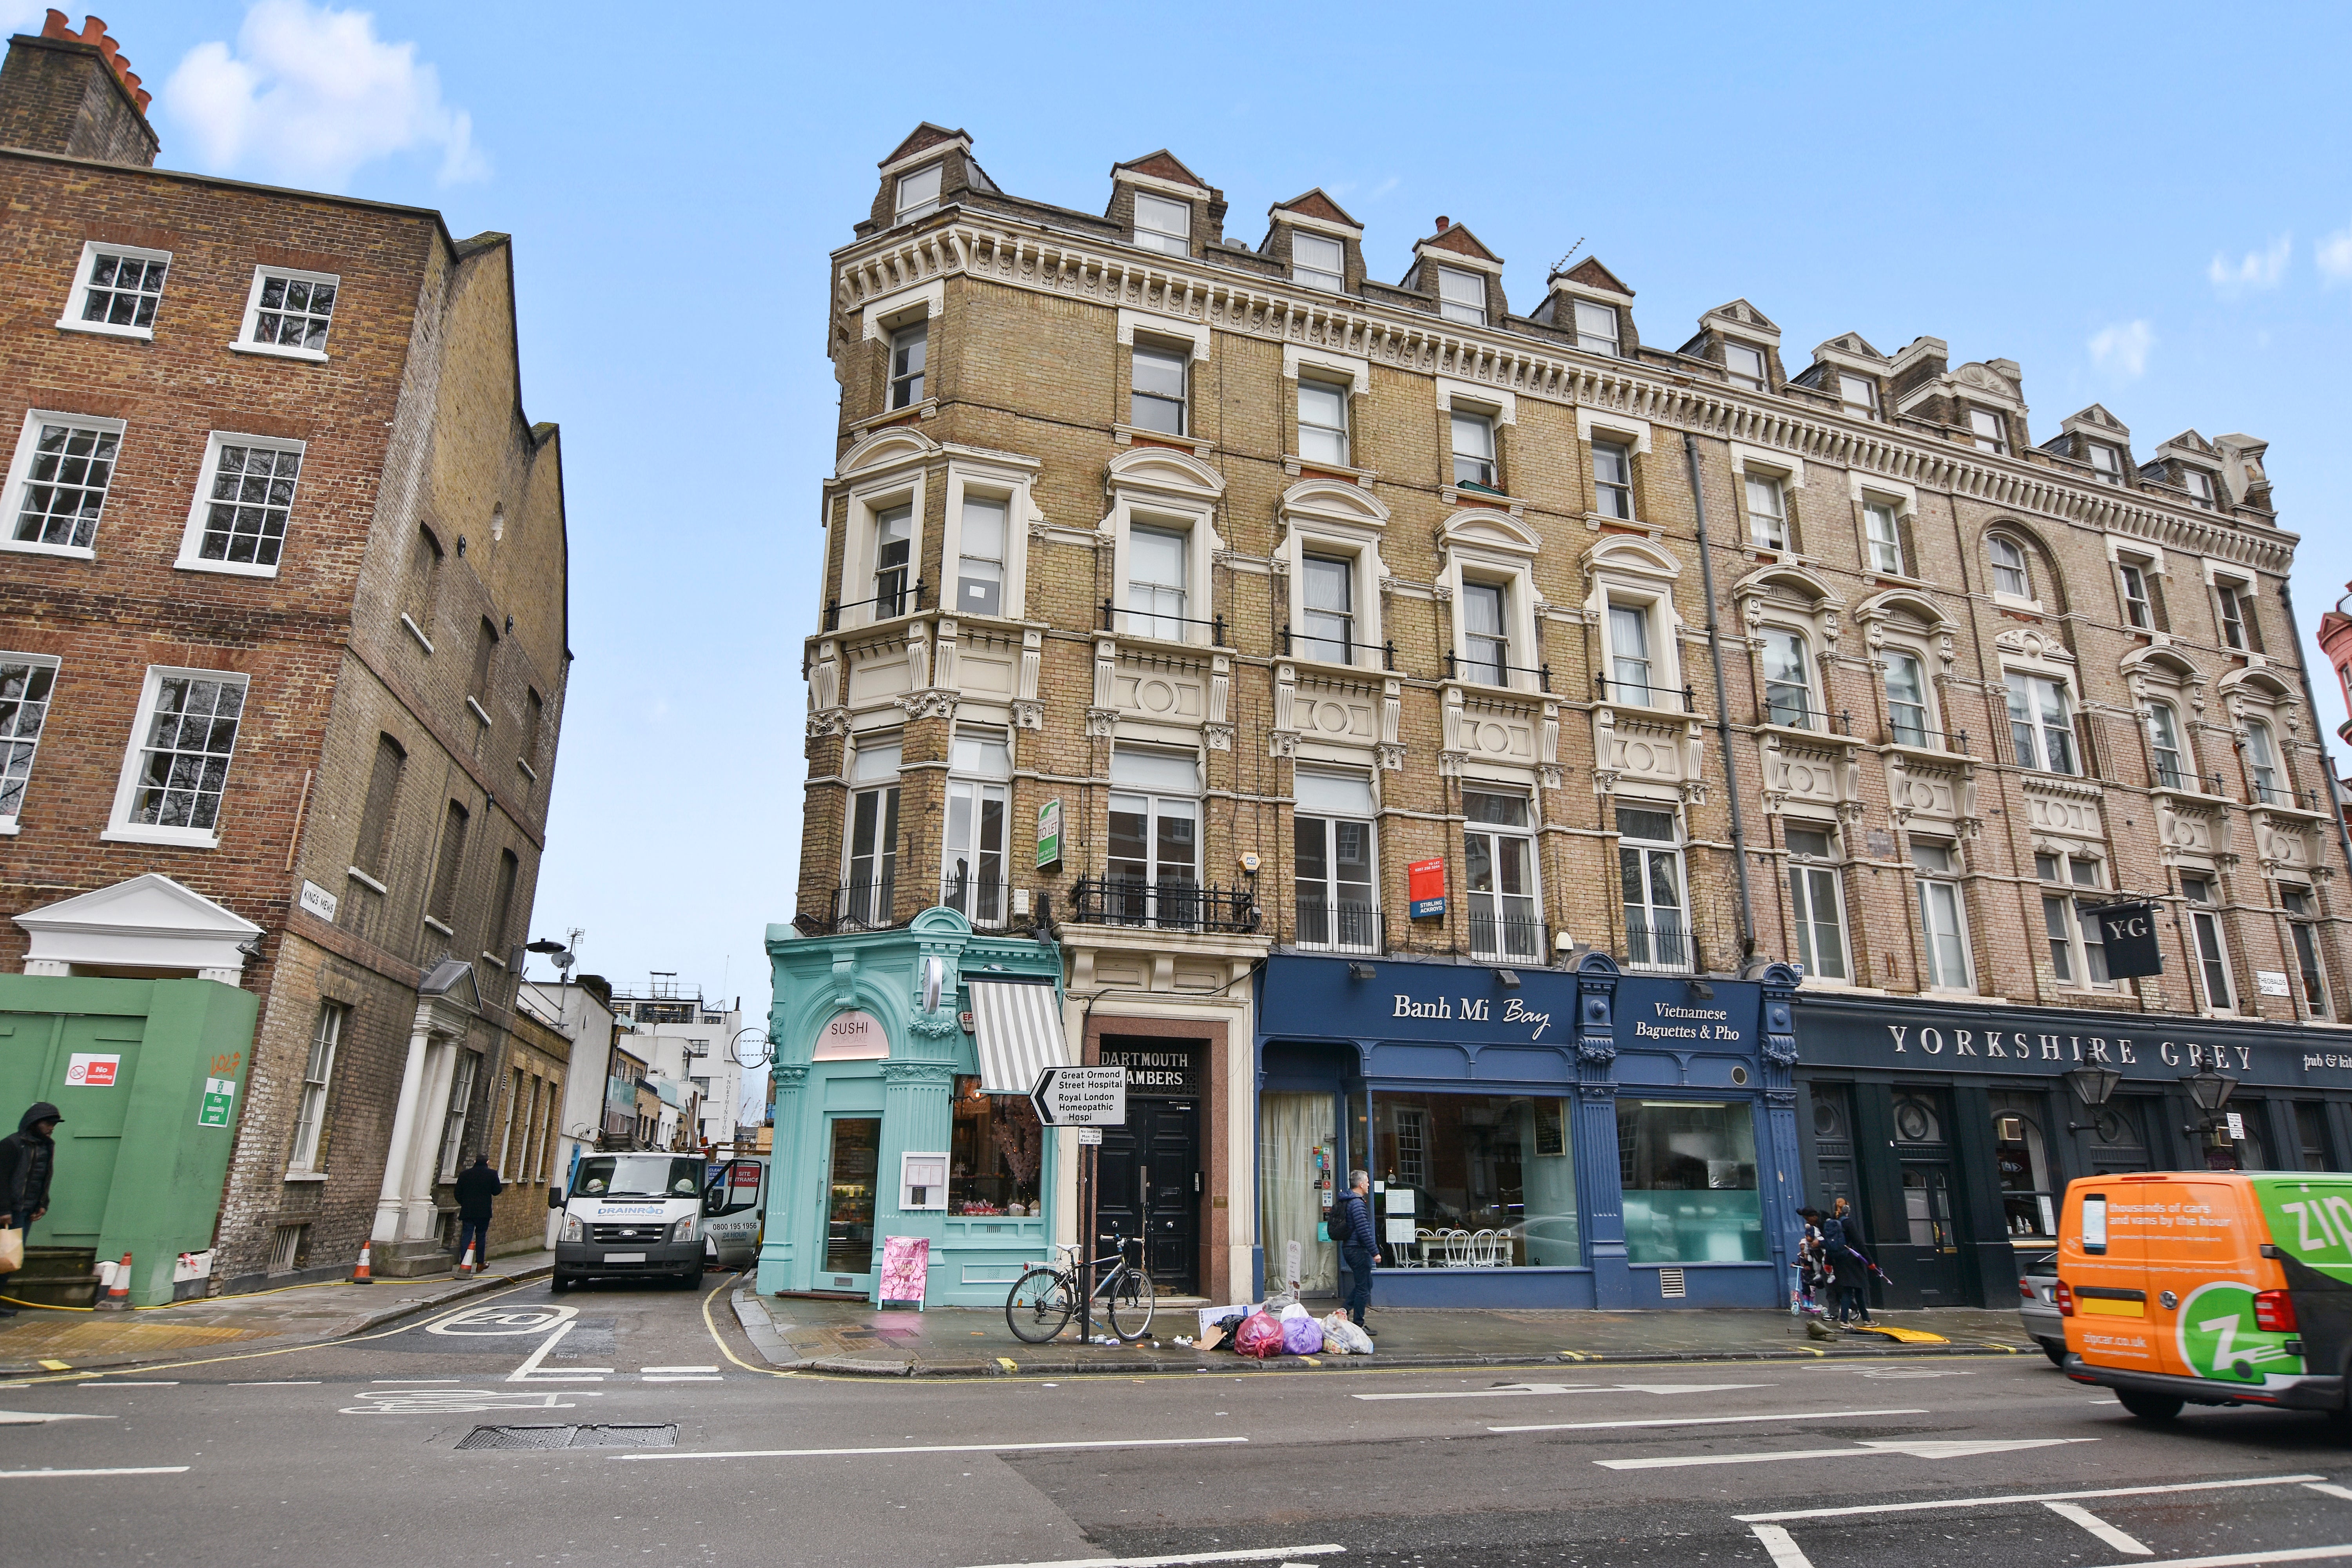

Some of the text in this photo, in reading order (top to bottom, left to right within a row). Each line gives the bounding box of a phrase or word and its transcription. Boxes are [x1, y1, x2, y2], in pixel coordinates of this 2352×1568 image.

[1039, 821, 1058, 839] TO LET
[320, 898, 334, 913] MEWS
[1654, 1002, 1727, 1020] Vietnamese
[1392, 995, 1551, 1041] Banh Mi Bay
[831, 1022, 868, 1035] SUSHI
[1635, 1022, 1740, 1040] Baguettes & Pho
[831, 1034, 867, 1045] CUPCAKE
[1887, 1025, 2251, 1070] YORKSHIRE GREY
[1101, 1051, 1188, 1067] DARTMOUTH
[2303, 1054, 2322, 1071] pub
[2325, 1054, 2337, 1067] &
[1087, 1070, 1120, 1079] Ormond
[1088, 1080, 1123, 1089] Hospital
[1058, 1093, 1114, 1102] Royal London
[207, 1106, 225, 1114] assembly
[1059, 1103, 1113, 1112] Homeopathic
[1069, 1113, 1092, 1122] Hospi
[2109, 1203, 2166, 1213] thousands
[2167, 1203, 2181, 1212] of
[2109, 1215, 2129, 1224] and
[2159, 1215, 2174, 1227] by
[2175, 1216, 2197, 1226] the
[456, 1314, 554, 1325] 20
[2083, 1332, 2147, 1348] zipcar.co.uk
